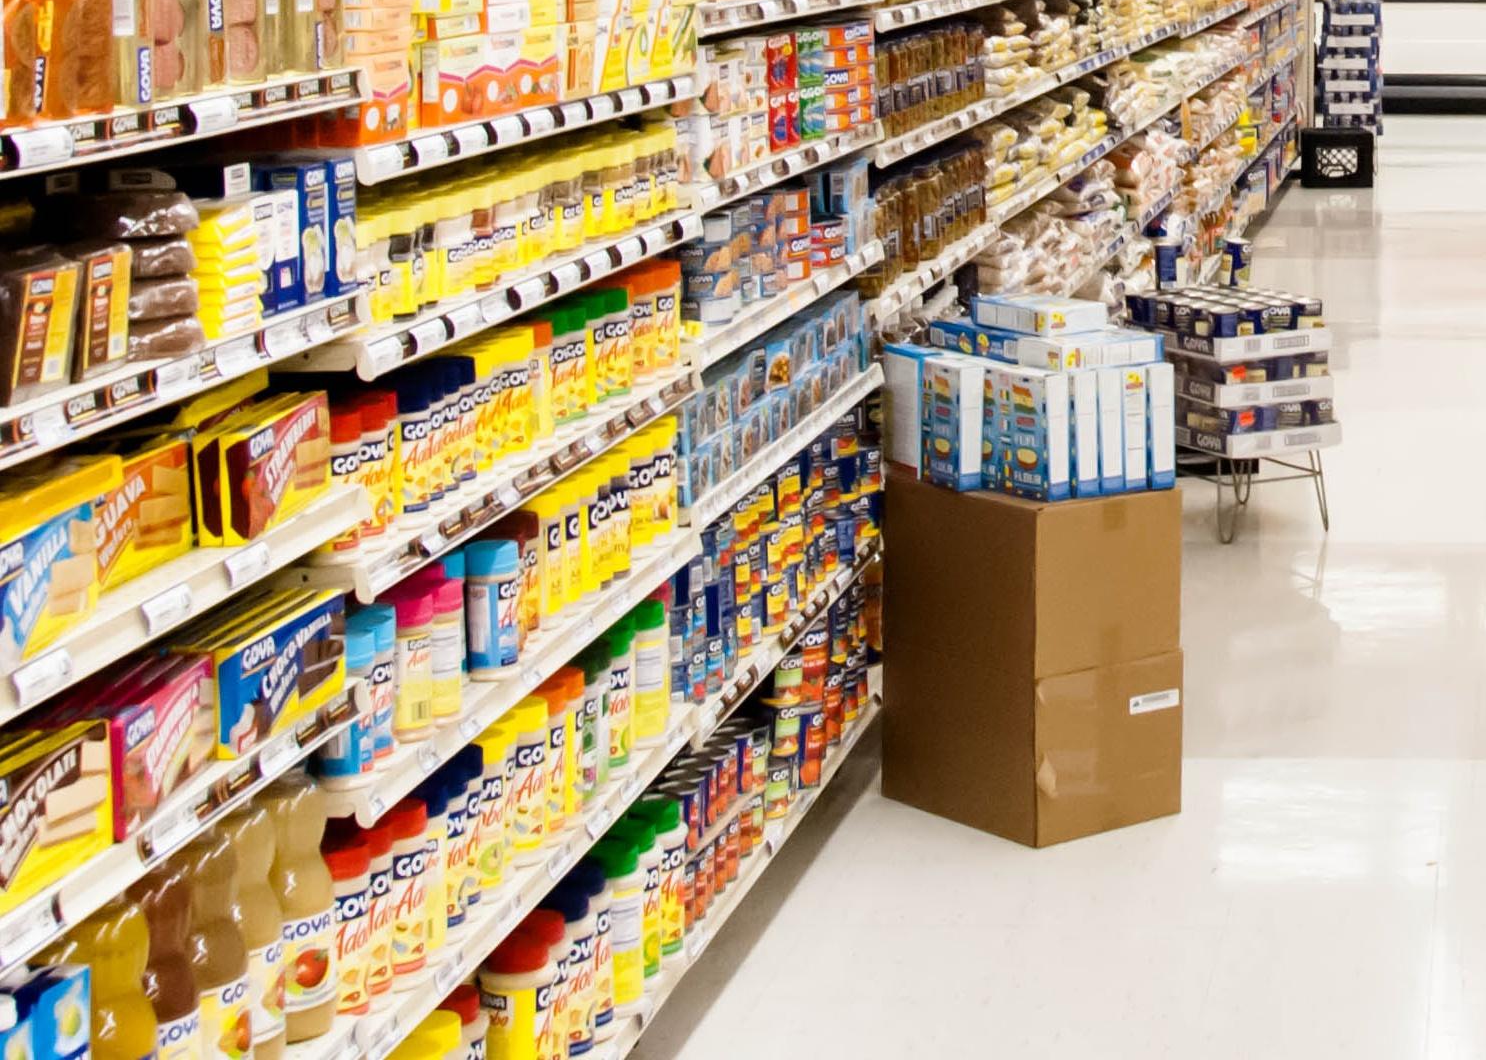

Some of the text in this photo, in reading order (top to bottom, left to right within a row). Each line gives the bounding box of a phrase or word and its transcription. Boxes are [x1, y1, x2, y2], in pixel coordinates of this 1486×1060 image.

[824, 72, 849, 85] GOYA
[1269, 306, 1291, 316] OYA
[1184, 336, 1210, 352] GOYA
[403, 423, 427, 439] GO
[250, 429, 274, 458] GOYA
[1197, 433, 1221, 451] GOYA
[333, 457, 356, 474] GO
[242, 635, 276, 669] GOYA
[127, 707, 156, 747] GOYA
[518, 748, 544, 766] GO
[396, 856, 424, 877] GO
[283, 915, 331, 940] GOYA
[222, 983, 248, 1005] GO
